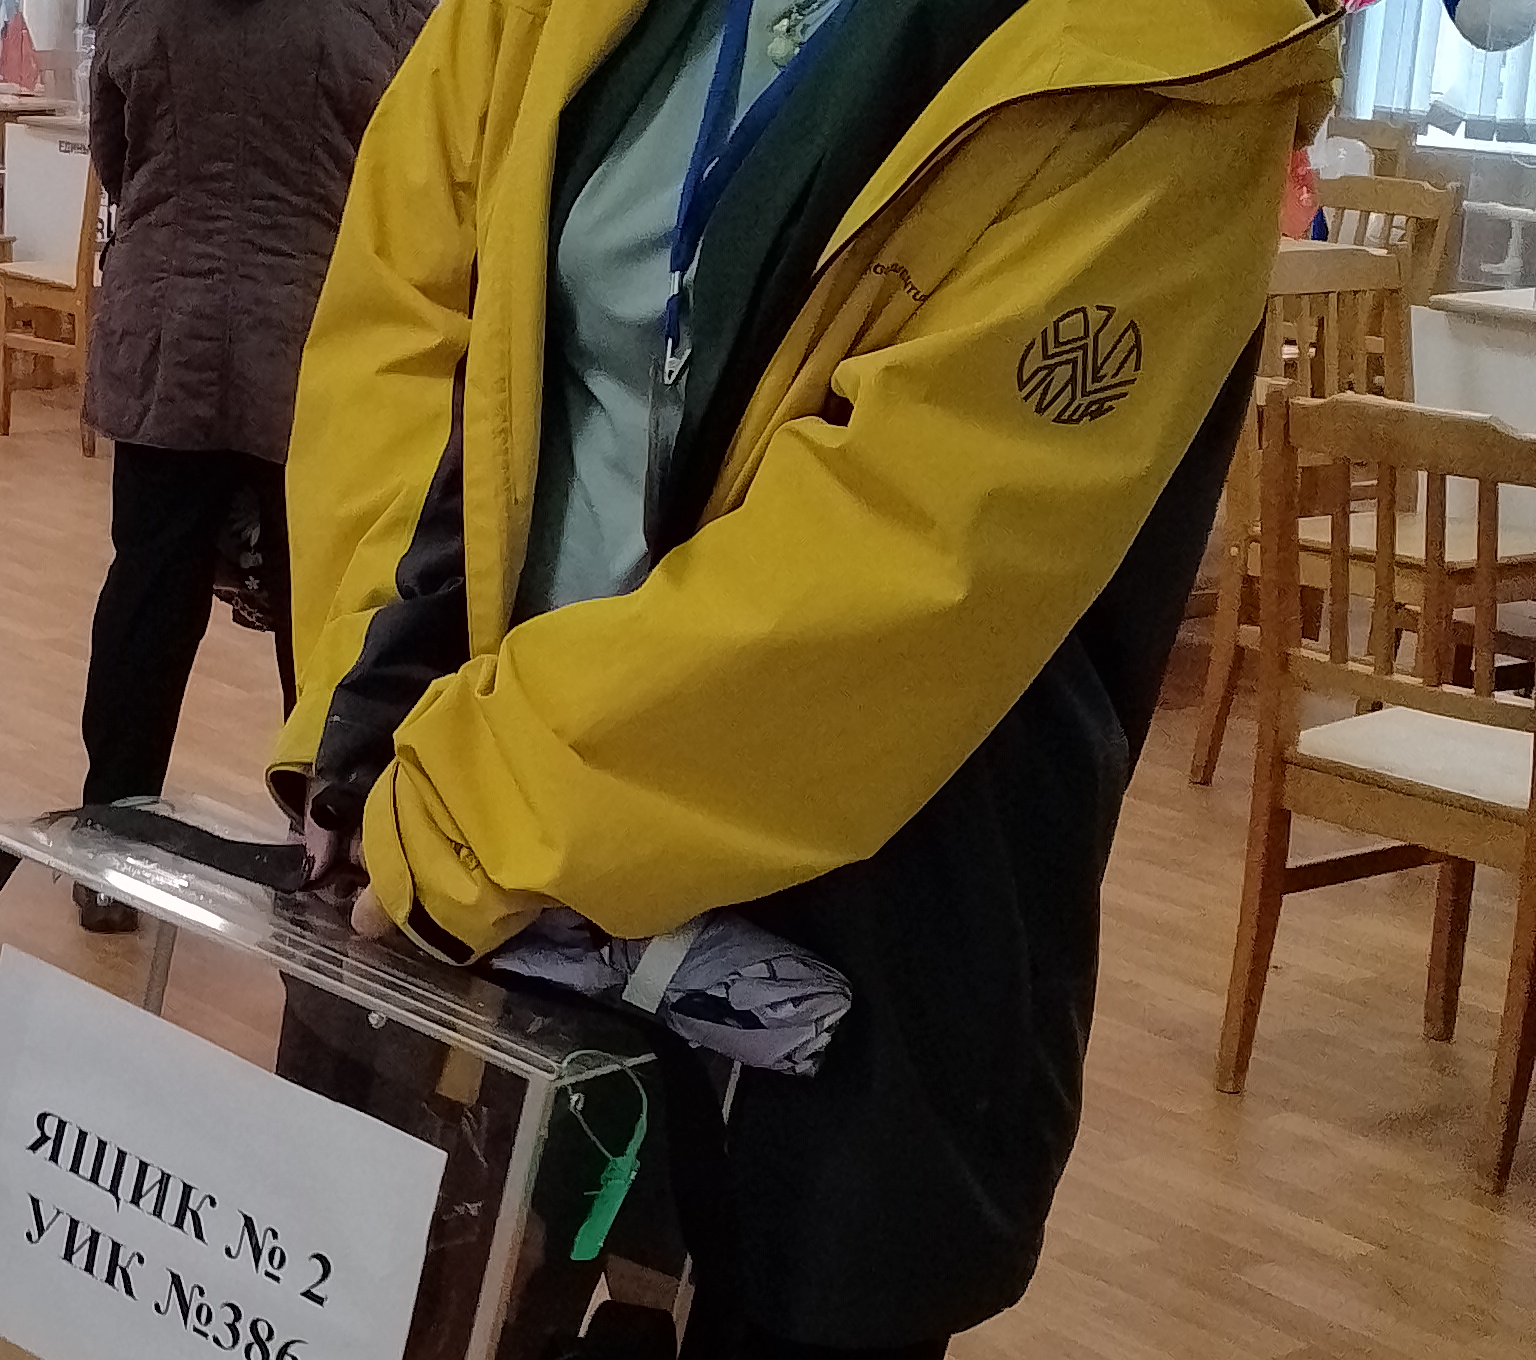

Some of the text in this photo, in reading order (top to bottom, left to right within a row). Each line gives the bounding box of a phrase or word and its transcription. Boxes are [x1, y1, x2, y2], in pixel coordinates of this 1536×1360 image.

[26, 1110, 333, 1307] ЯЩИК № 2
[26, 1194, 144, 1301] УИК
